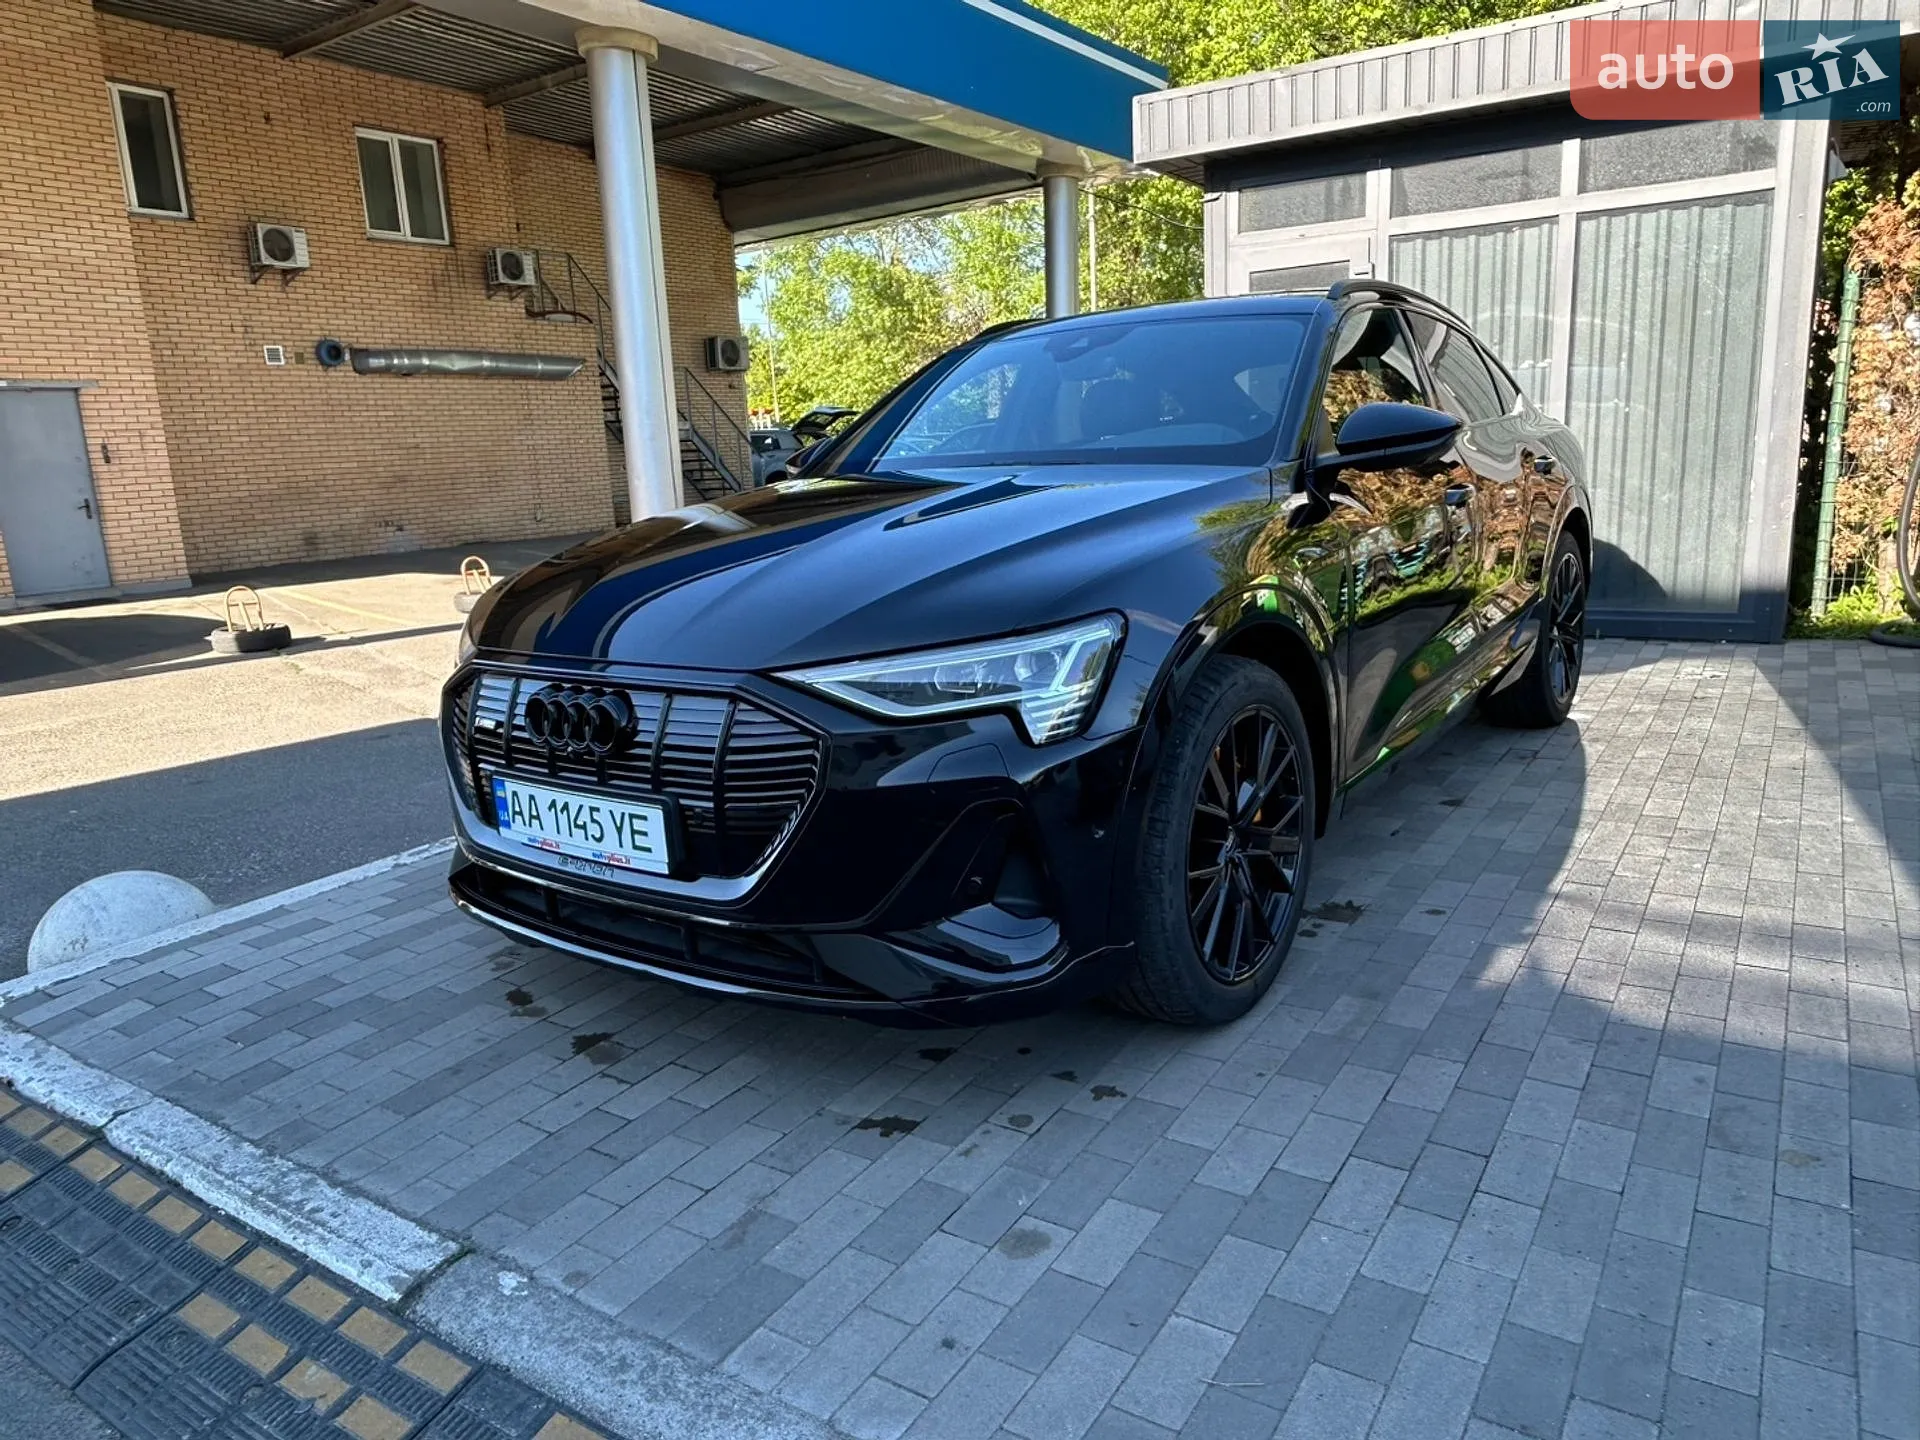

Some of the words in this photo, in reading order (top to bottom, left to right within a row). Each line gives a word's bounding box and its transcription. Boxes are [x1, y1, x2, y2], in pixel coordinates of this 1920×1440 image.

[511, 790, 544, 831] AA
[547, 798, 605, 843] 1145
[608, 808, 653, 853] YE
